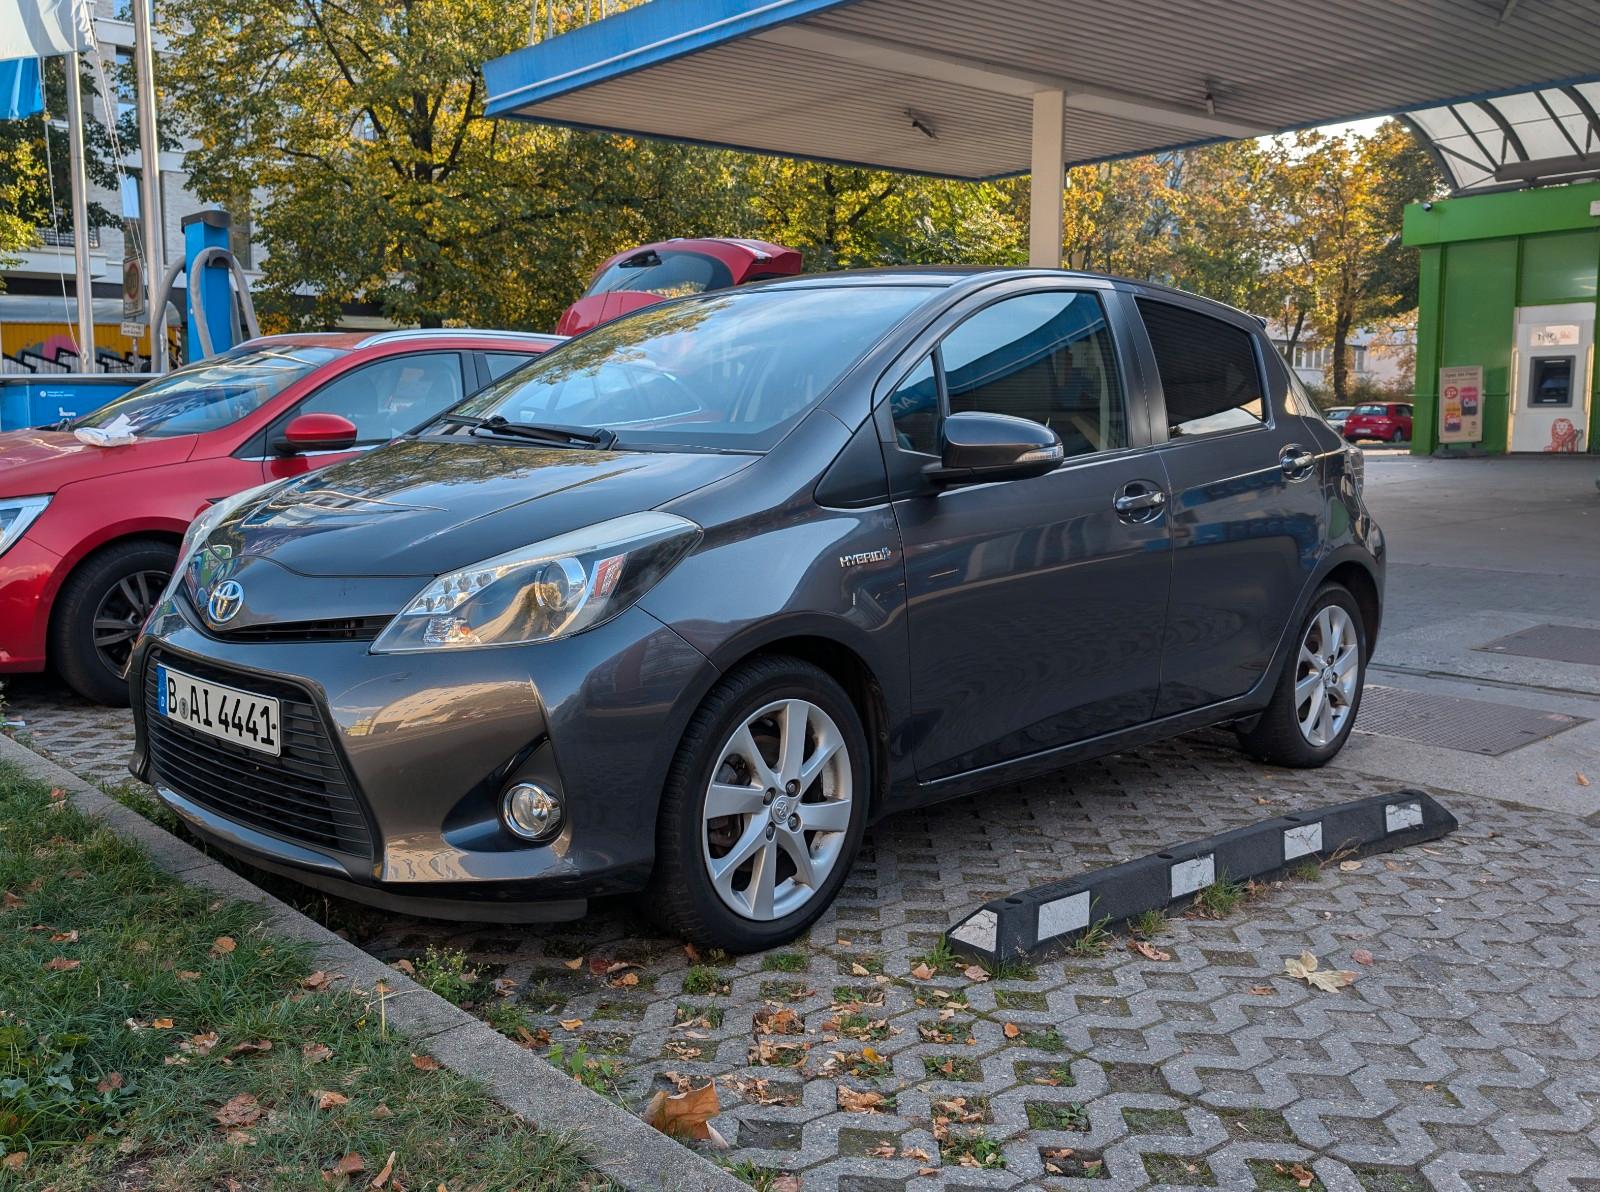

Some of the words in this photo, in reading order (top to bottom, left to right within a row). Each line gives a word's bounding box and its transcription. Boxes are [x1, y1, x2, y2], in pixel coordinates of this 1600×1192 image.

[839, 550, 883, 568] HYBRID
[168, 677, 178, 714] B
[190, 686, 213, 728] AI
[218, 695, 275, 746] 4441
